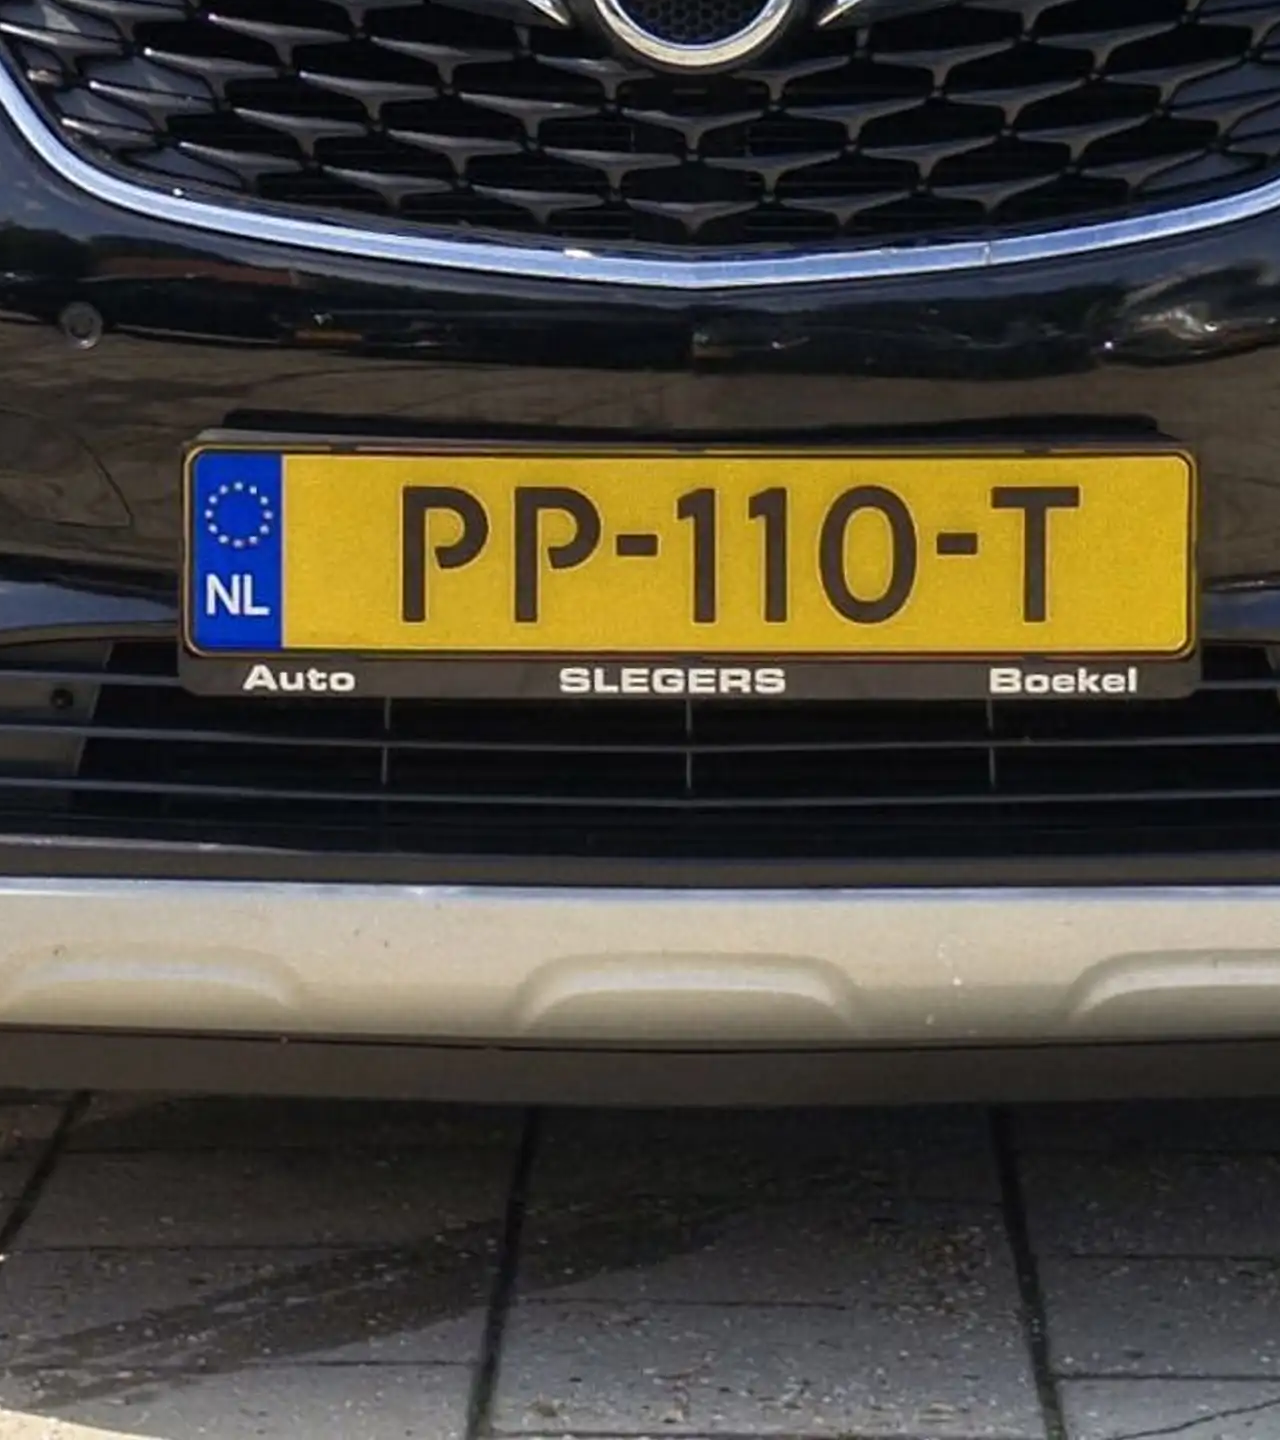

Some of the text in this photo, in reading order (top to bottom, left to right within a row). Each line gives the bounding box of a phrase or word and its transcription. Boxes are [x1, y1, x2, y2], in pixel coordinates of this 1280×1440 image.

[400, 484, 1081, 624] PP-110-T
[205, 573, 271, 616] NL
[242, 664, 1138, 694] Auto SLEGERS Boekel
